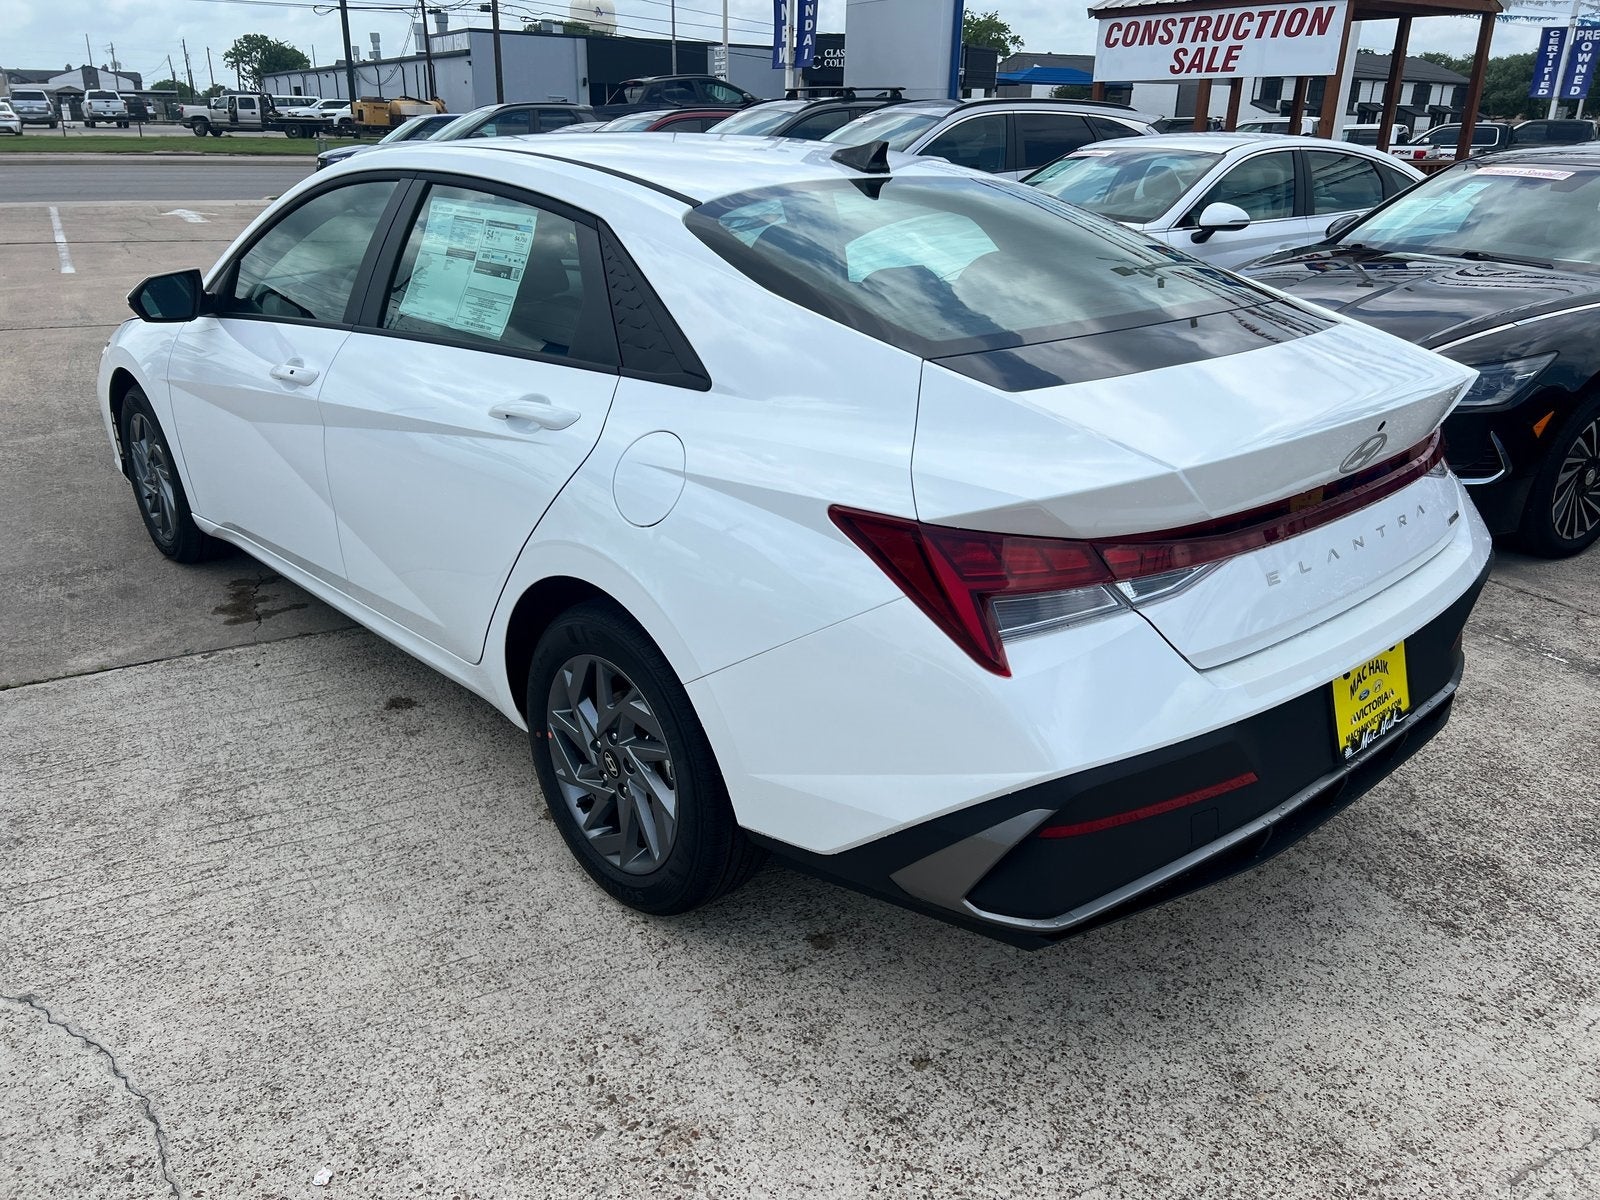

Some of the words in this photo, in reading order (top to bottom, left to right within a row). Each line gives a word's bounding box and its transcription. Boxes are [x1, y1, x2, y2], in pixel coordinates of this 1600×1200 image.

[803, 0, 814, 59] NDAI
[1104, 6, 1336, 48] CONSTRUCTION
[1576, 30, 1600, 41] PRE
[1169, 45, 1243, 74] SALE
[1537, 30, 1560, 95] CERTIFIED
[1569, 42, 1593, 95] OWNED
[1265, 504, 1426, 587] ELANTRA
[1349, 665, 1368, 700] MAC
[1368, 659, 1390, 676] HAIK
